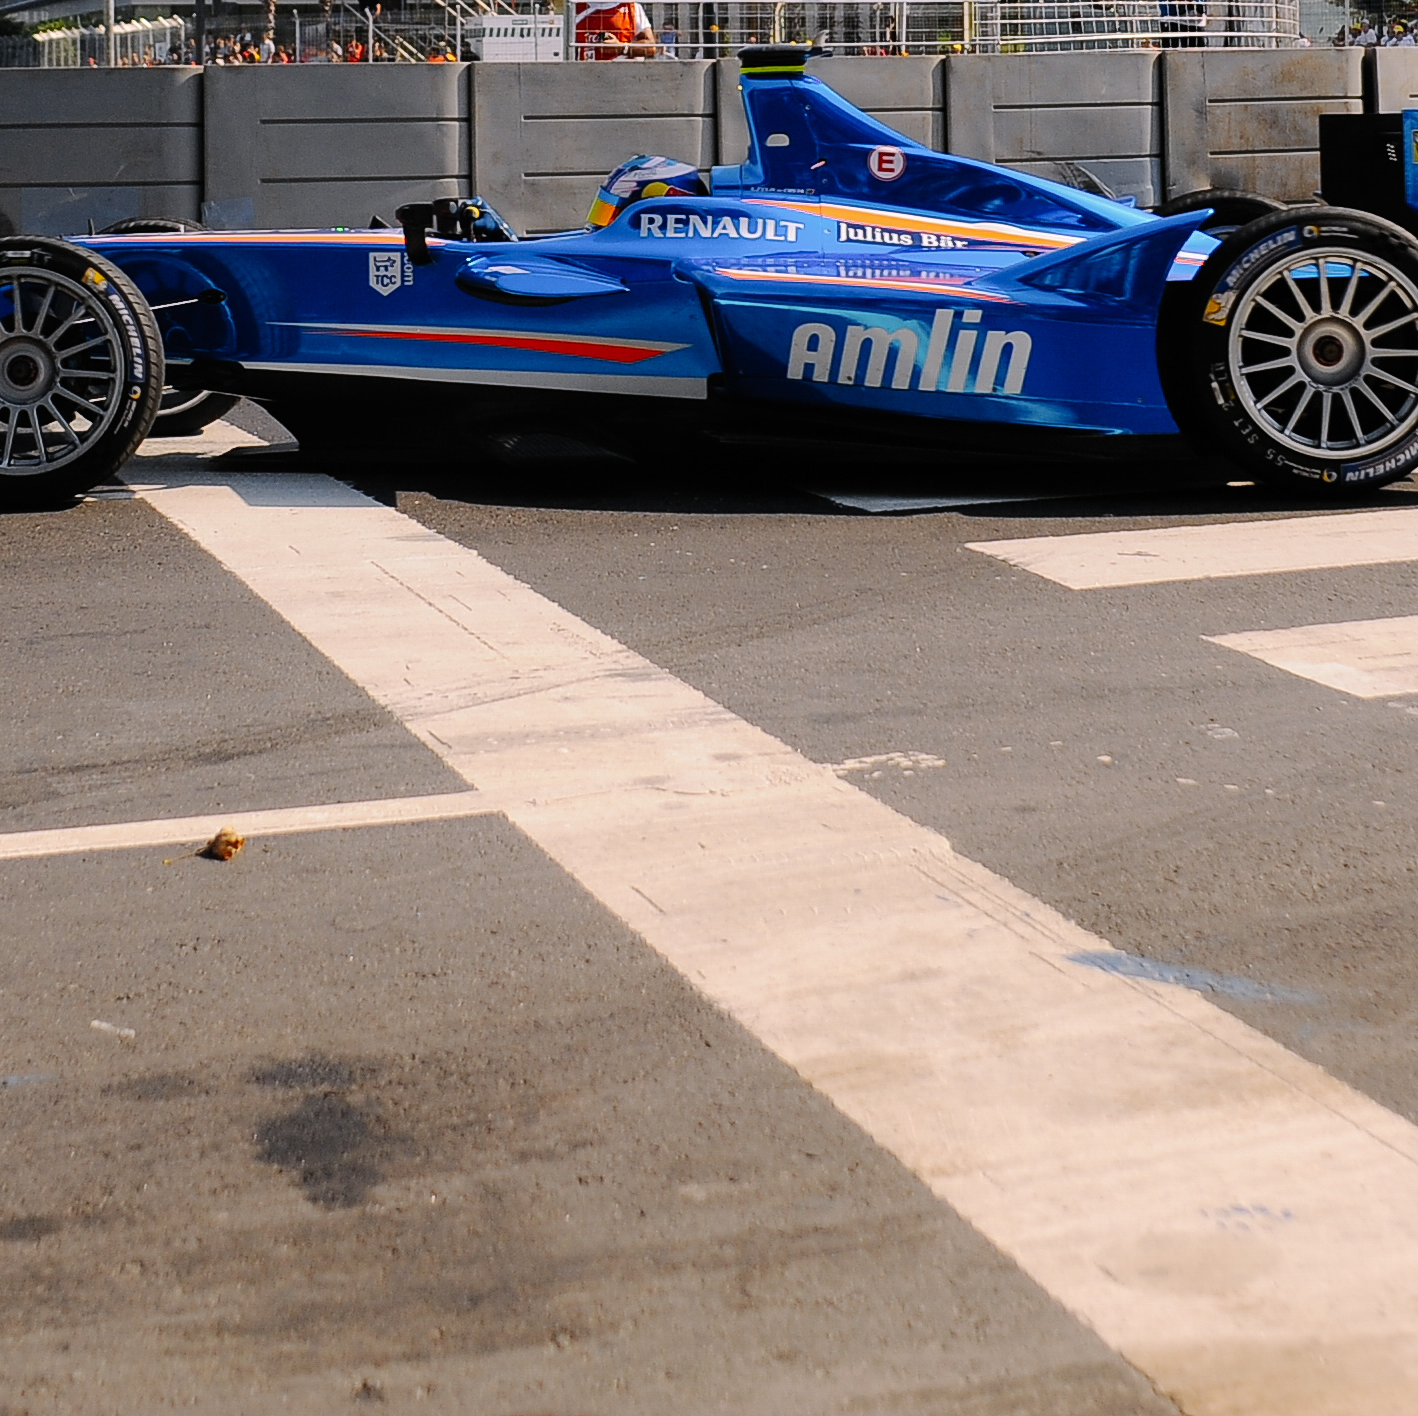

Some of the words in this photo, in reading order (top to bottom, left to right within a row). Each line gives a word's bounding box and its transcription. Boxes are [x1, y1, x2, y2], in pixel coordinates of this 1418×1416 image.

[877, 151, 896, 173] E
[639, 213, 805, 243] RENAULT
[838, 222, 914, 246] Julius
[1226, 229, 1298, 288] MICHELIN
[374, 274, 397, 288] TCC
[107, 293, 144, 379] MICHELIN
